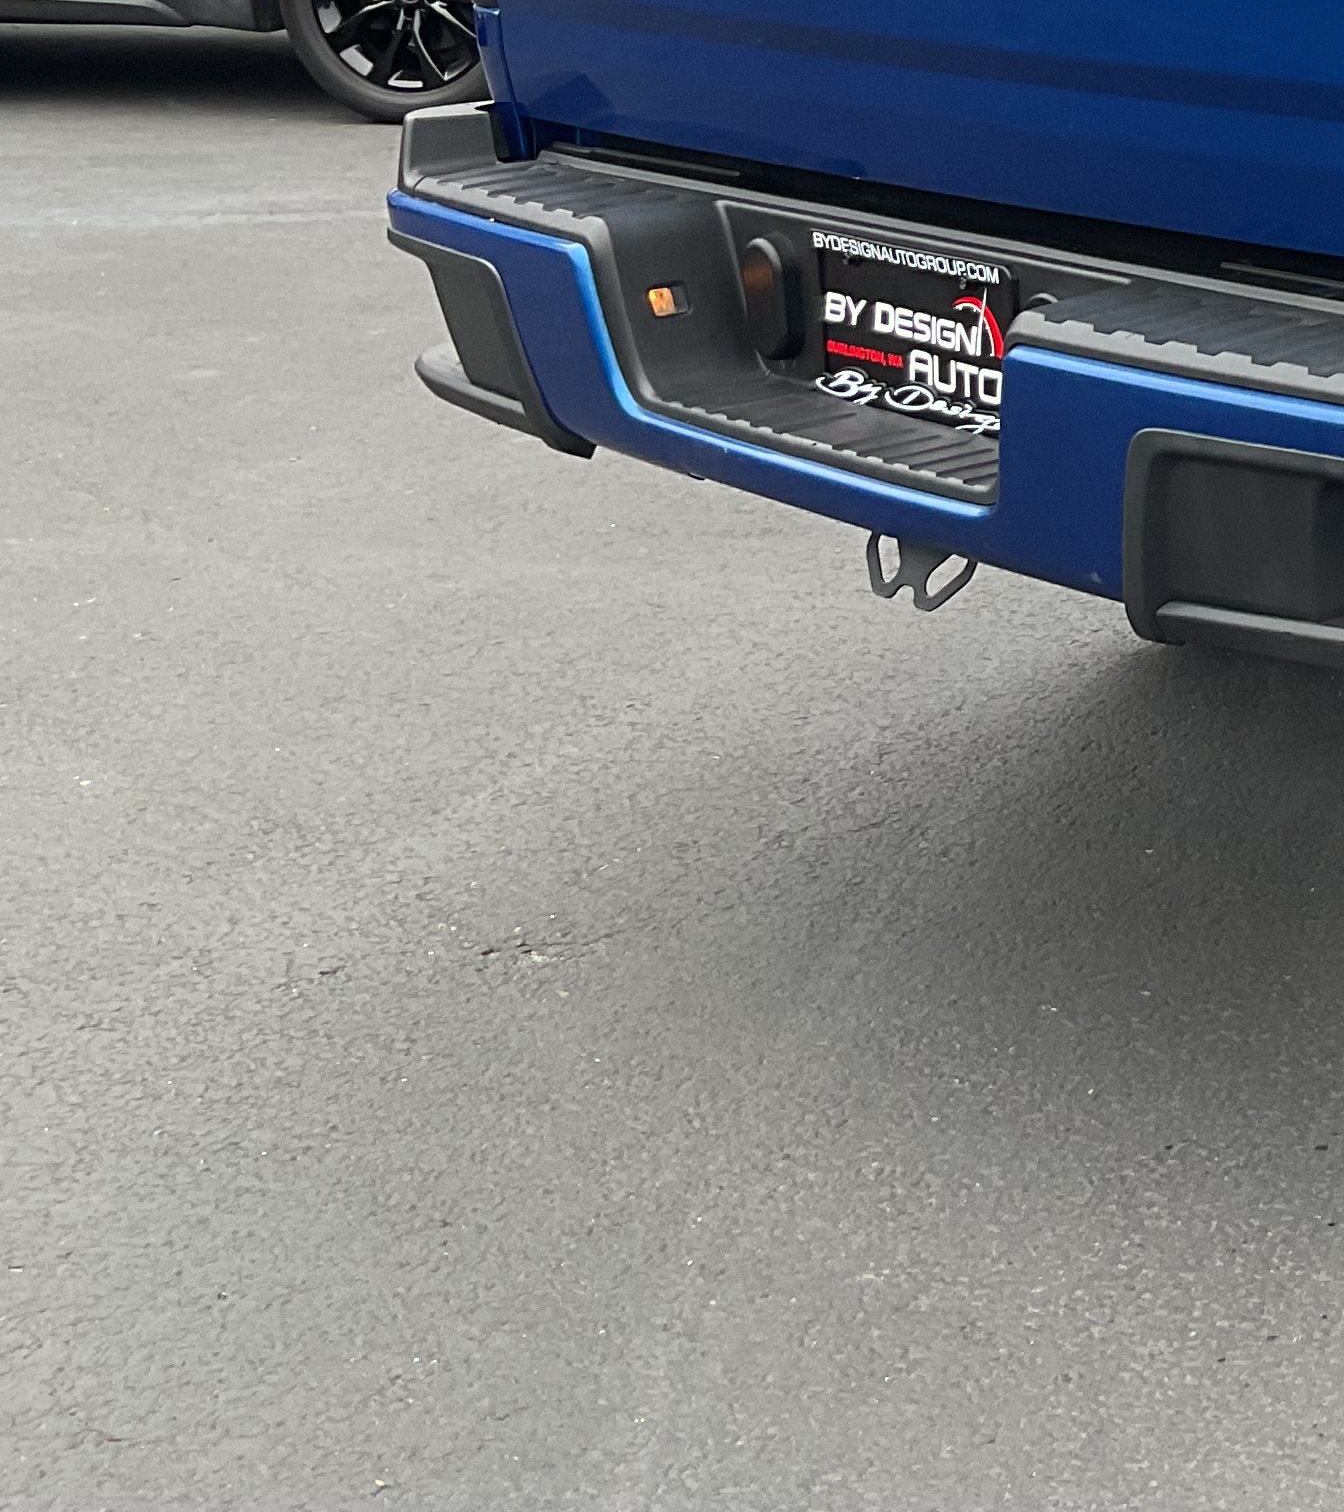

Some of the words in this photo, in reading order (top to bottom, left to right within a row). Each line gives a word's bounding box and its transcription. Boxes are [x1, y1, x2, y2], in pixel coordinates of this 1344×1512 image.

[812, 230, 1000, 285] BYDESIGNAUTOGROUP.COM
[824, 291, 867, 326] BY
[872, 300, 979, 357] DESIGN
[815, 369, 884, 405] By
[909, 348, 1002, 406] AUTO
